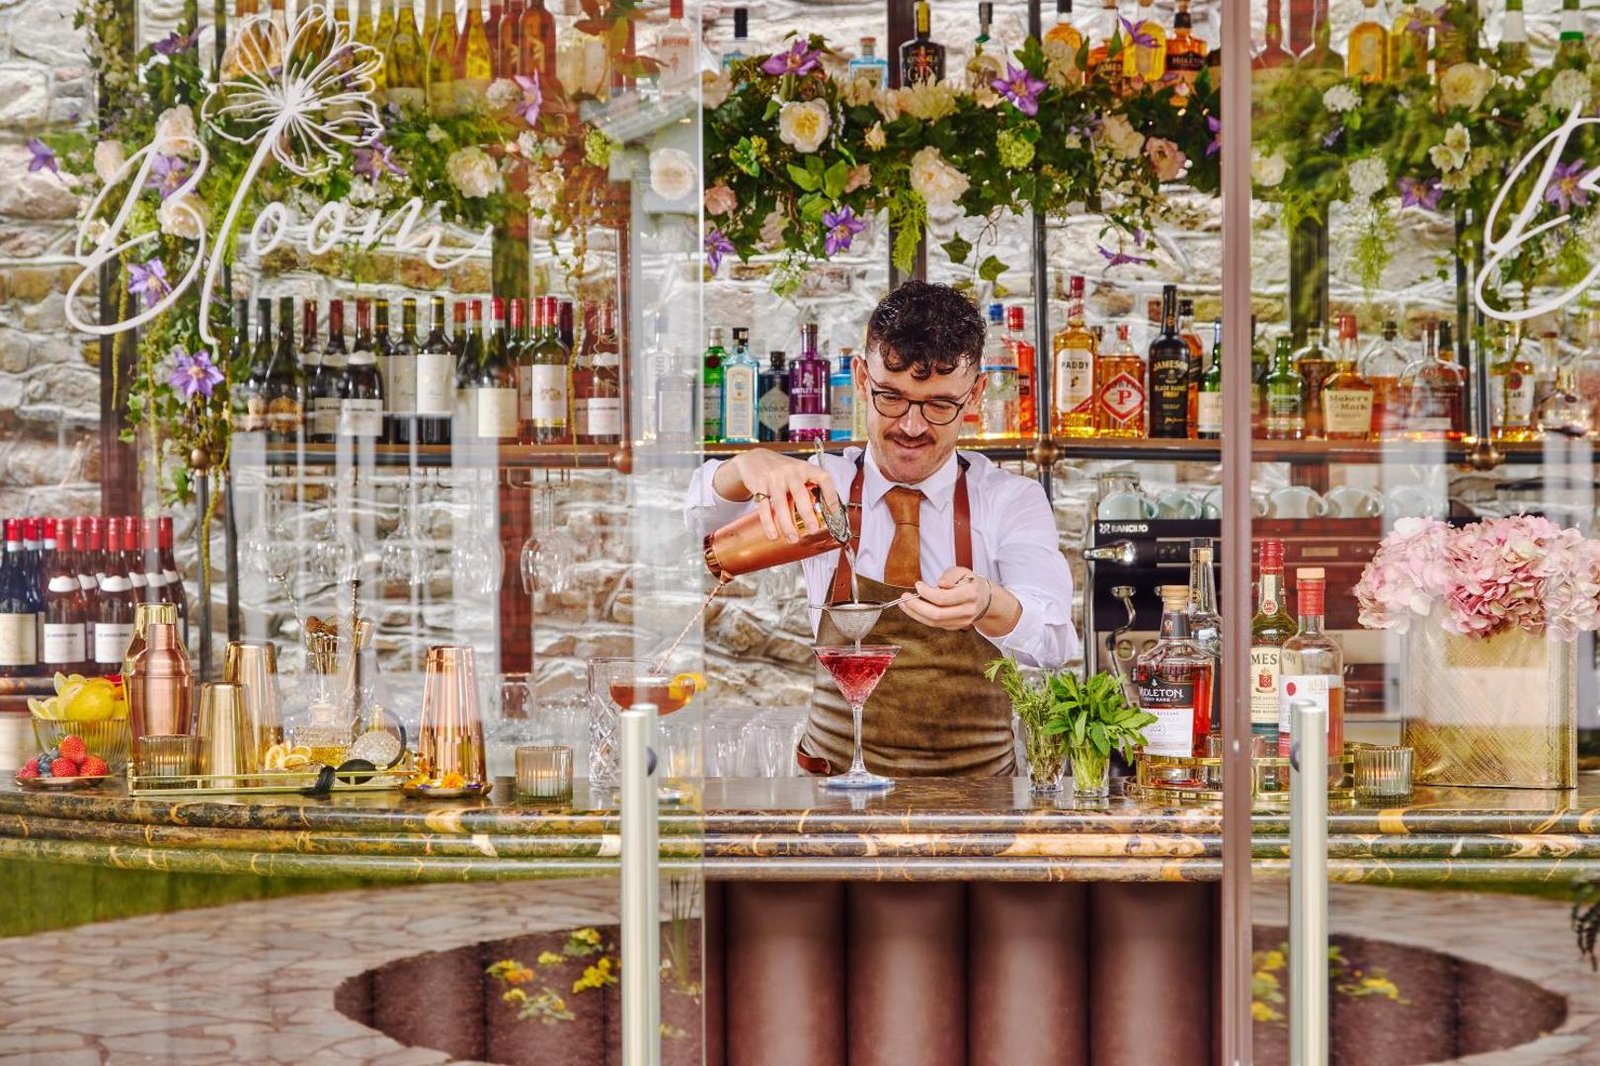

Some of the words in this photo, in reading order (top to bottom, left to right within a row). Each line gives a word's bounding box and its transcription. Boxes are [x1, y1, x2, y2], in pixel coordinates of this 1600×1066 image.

[65, 100, 494, 345] Bloom
[1061, 361, 1089, 369] PADDY
[1117, 389, 1132, 405] P
